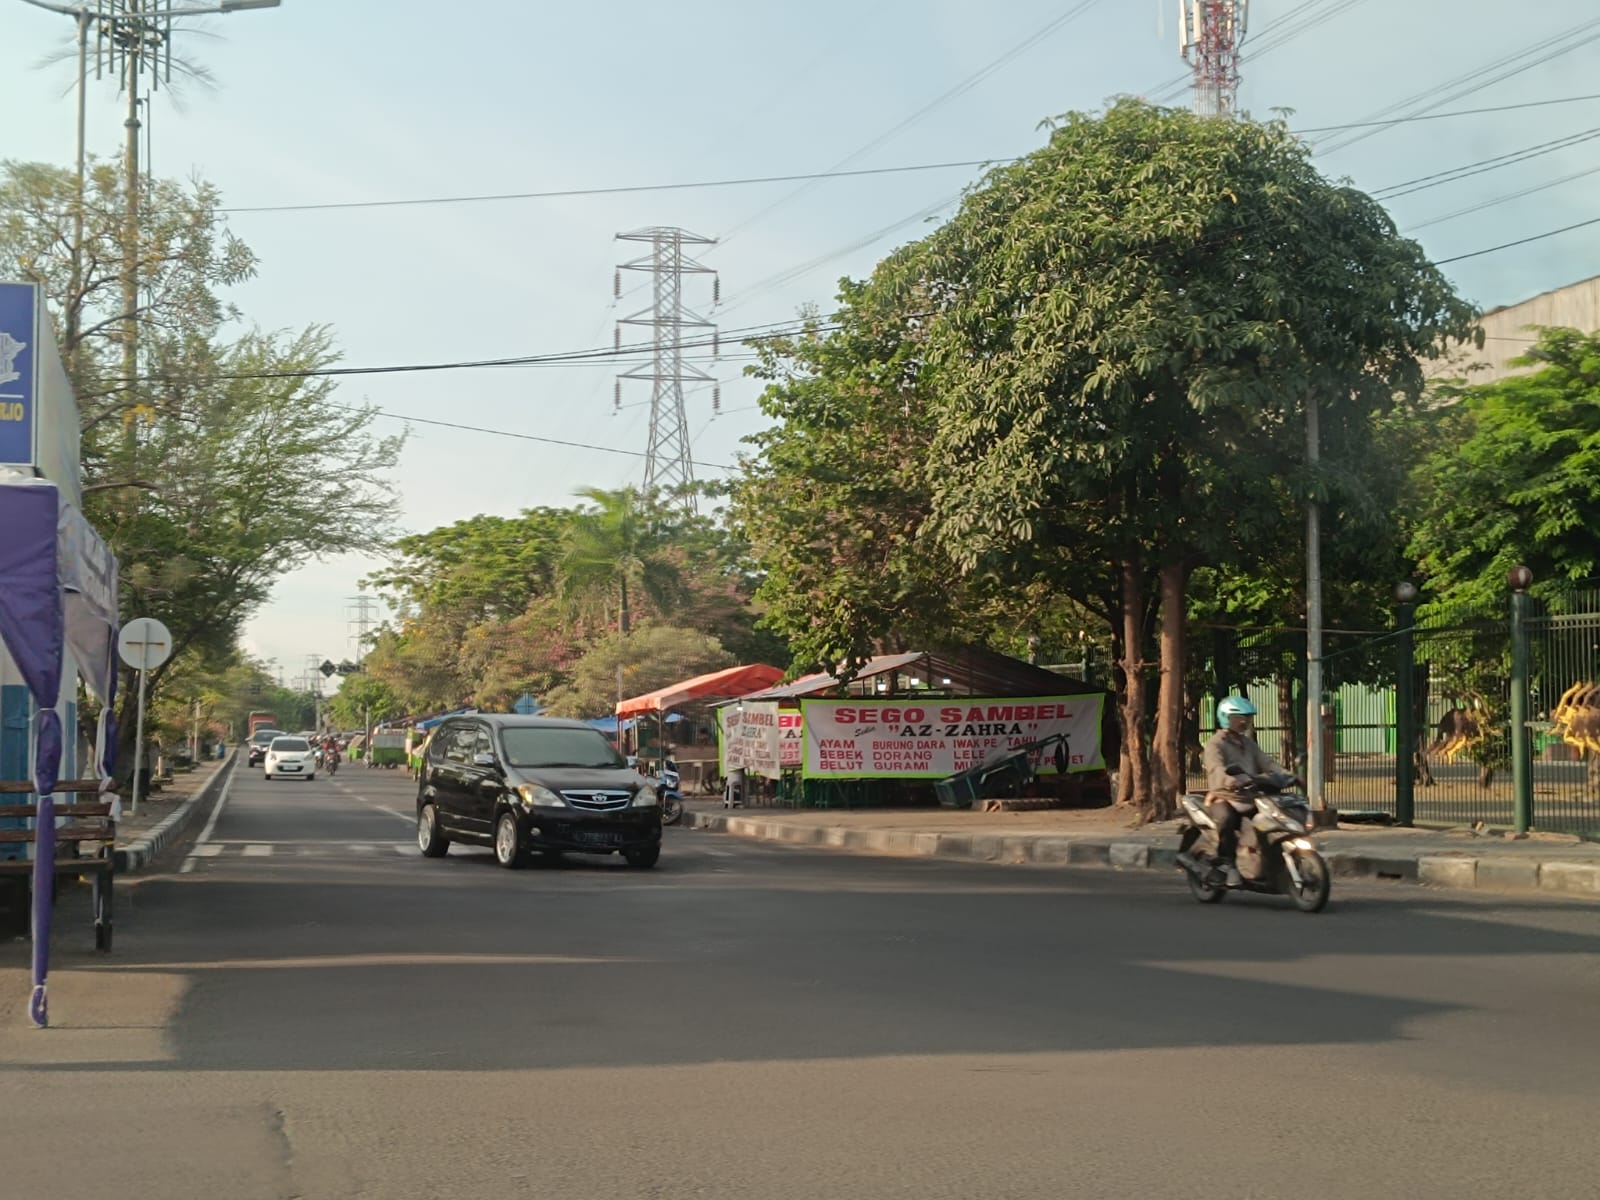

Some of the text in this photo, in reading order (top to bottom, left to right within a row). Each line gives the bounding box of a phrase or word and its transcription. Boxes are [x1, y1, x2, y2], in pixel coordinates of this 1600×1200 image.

[835, 704, 1073, 723] SEGO SAMBEL
[820, 739, 855, 749] AYAM
[872, 741, 914, 750] BURUNG
[917, 740, 946, 750] DARA
[953, 739, 980, 748] IWAK
[984, 738, 998, 747] PE
[820, 750, 985, 760] BEBEK DORANG LELE
[820, 761, 863, 770] BELUT
[873, 761, 929, 770] GURAMI
